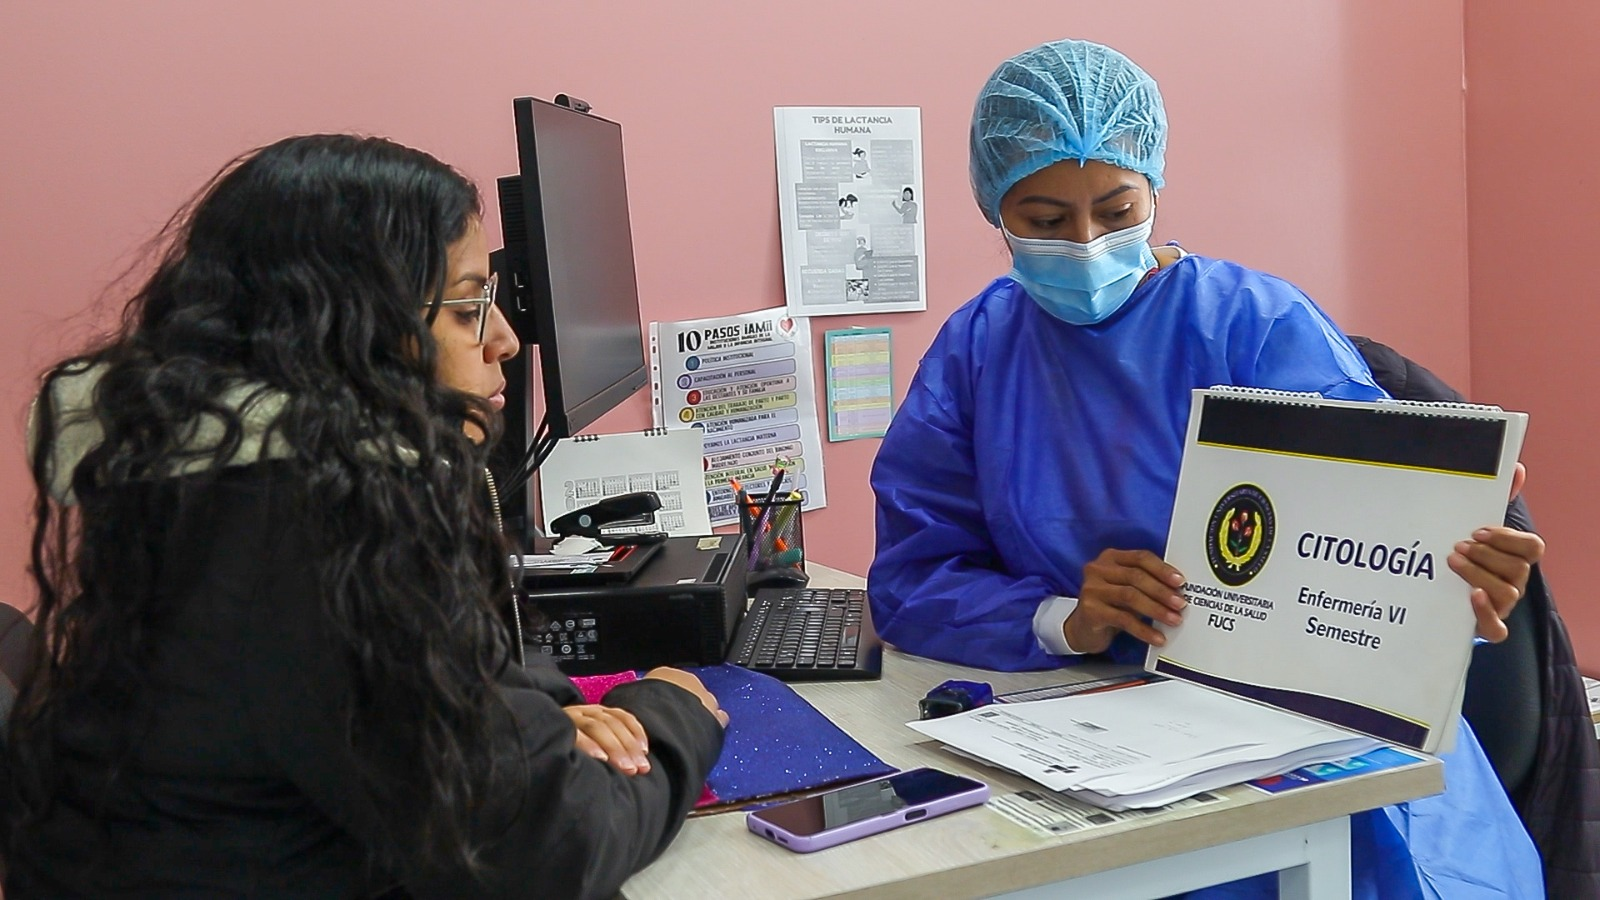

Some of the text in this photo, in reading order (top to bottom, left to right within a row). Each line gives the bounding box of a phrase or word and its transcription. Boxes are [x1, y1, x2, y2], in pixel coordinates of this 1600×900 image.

[812, 116, 830, 124] TIPS
[844, 116, 892, 124] LACTANCIA
[678, 330, 702, 352] 10
[704, 325, 740, 340] PASOS
[723, 352, 754, 360] INSTITUCIONAL
[1298, 532, 1434, 580] CITOLOGÍA
[1194, 597, 1223, 610] CIENCIAS
[1224, 604, 1233, 613] DE
[1234, 606, 1242, 615] LA
[1244, 608, 1267, 620] SALUD
[1224, 592, 1274, 610] UNIVERSITARIA
[1298, 587, 1406, 624] Enfermería VI
[1208, 614, 1235, 631] FUCS
[1305, 616, 1381, 649] Semestre
